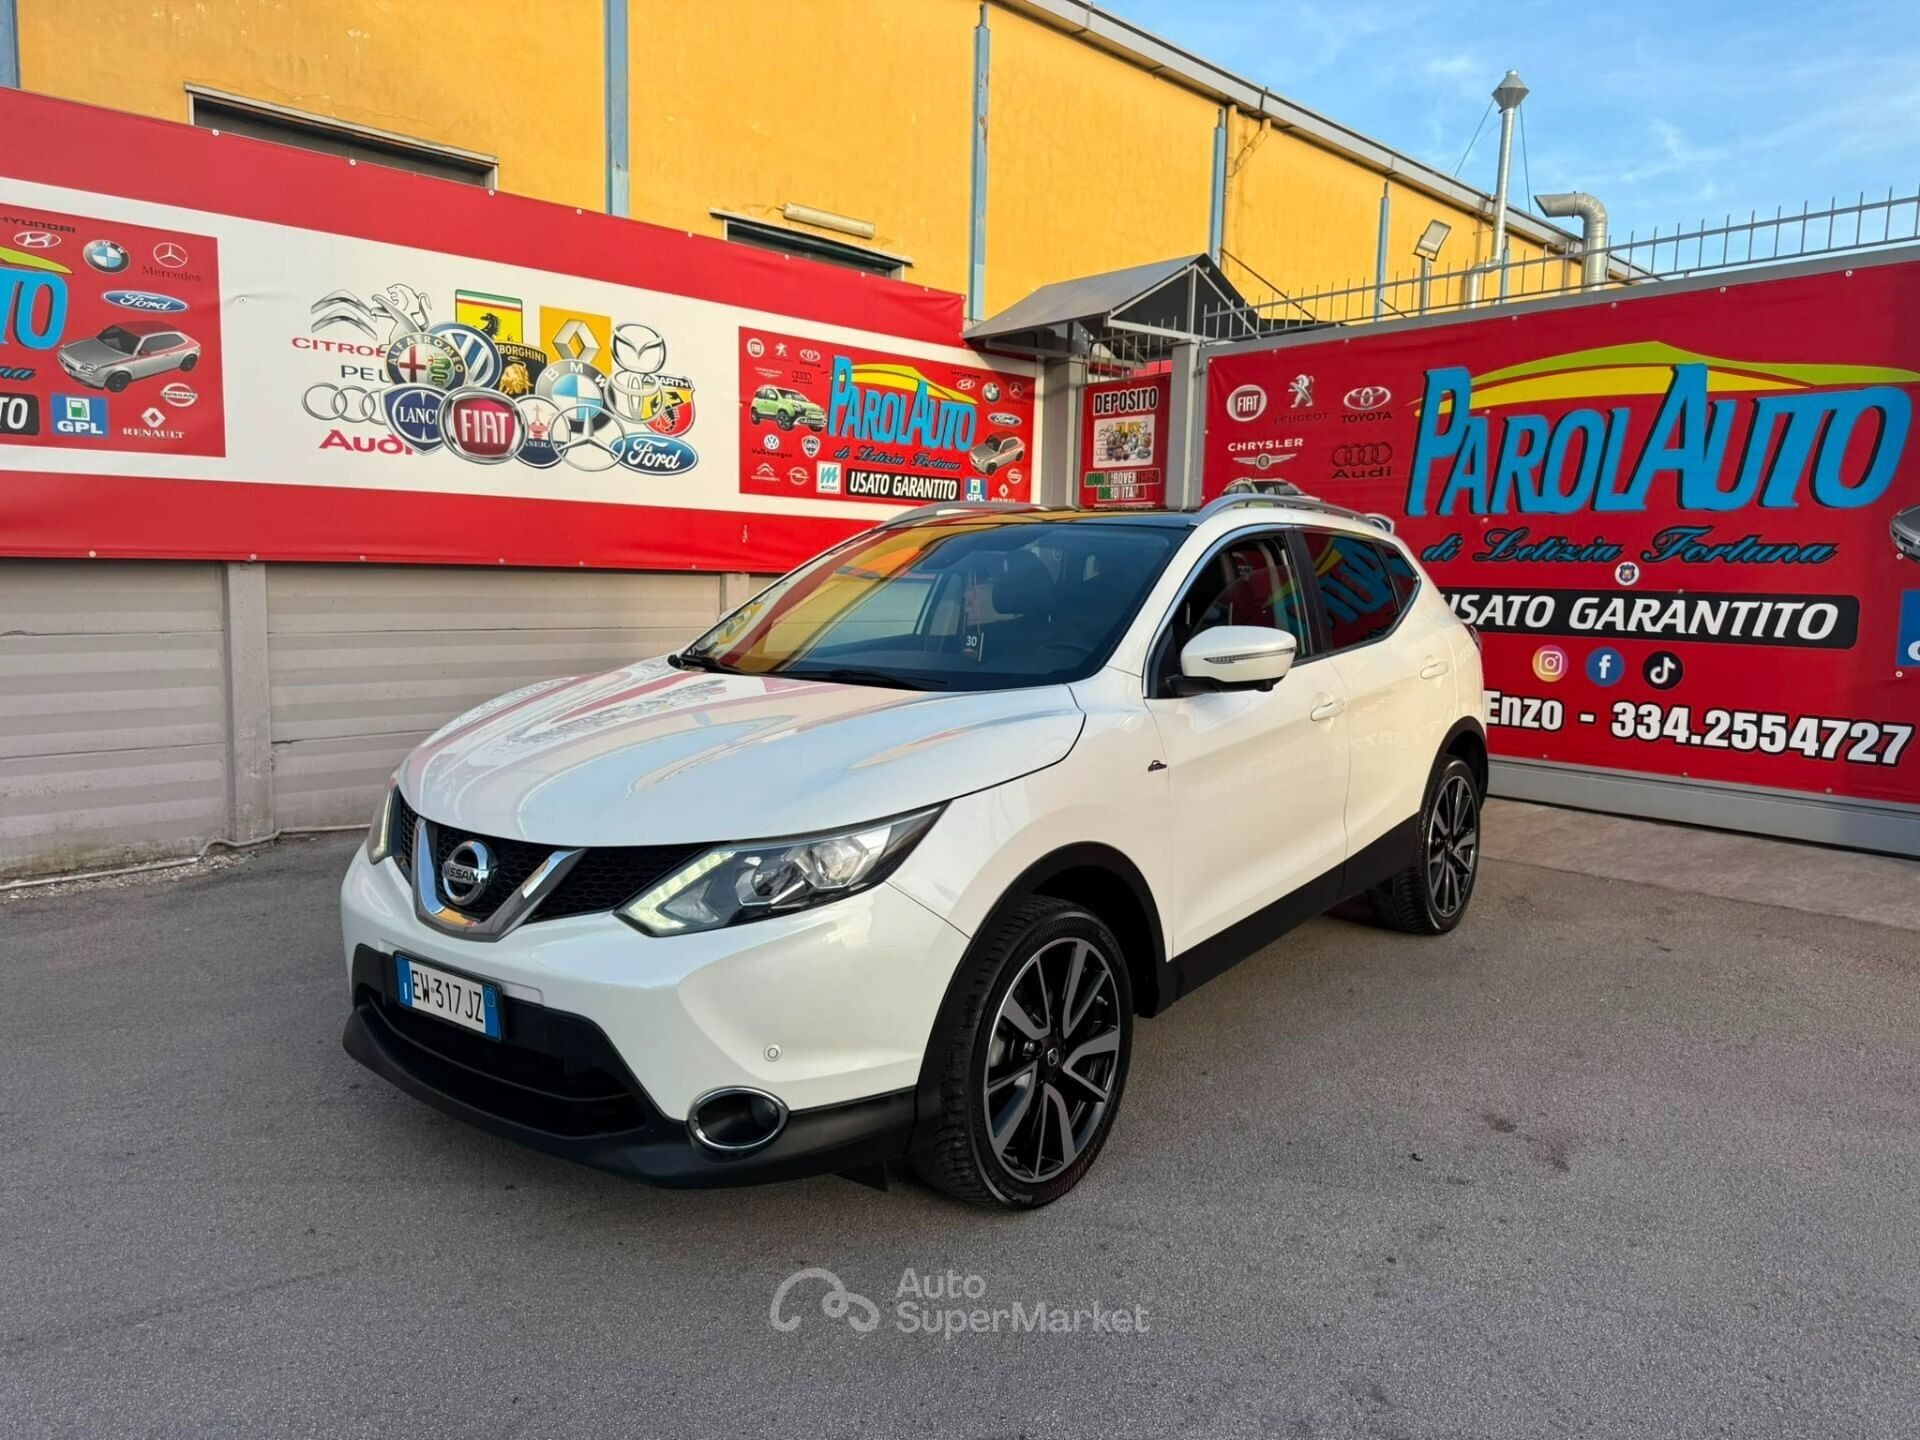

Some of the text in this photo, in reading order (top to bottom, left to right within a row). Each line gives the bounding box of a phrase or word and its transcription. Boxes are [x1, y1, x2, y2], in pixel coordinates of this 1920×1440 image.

[142, 266, 201, 281] Mercedes
[120, 292, 171, 311] Ford
[388, 337, 414, 366] ALFA
[1094, 387, 1157, 414] DEPOSITO
[1237, 393, 1259, 413] FIAT
[460, 408, 509, 445] FIAT
[1274, 412, 1329, 424] PEUGEOT
[1341, 411, 1392, 423] TOYOTA
[57, 420, 103, 434] GPL
[123, 427, 184, 439] RENAULT
[628, 438, 681, 469] Ford
[1228, 438, 1304, 452] CHRYSLER
[1331, 466, 1393, 479] Audi
[849, 471, 958, 500] USATO GARANTITO
[1421, 525, 1841, 564] di Letizia Fortuna
[1568, 595, 1840, 640] GARANTITO
[965, 635, 978, 648] 30
[1484, 690, 1564, 731] Enzo
[1611, 700, 1913, 765] 334.2554727
[445, 865, 479, 882] NISSAN
